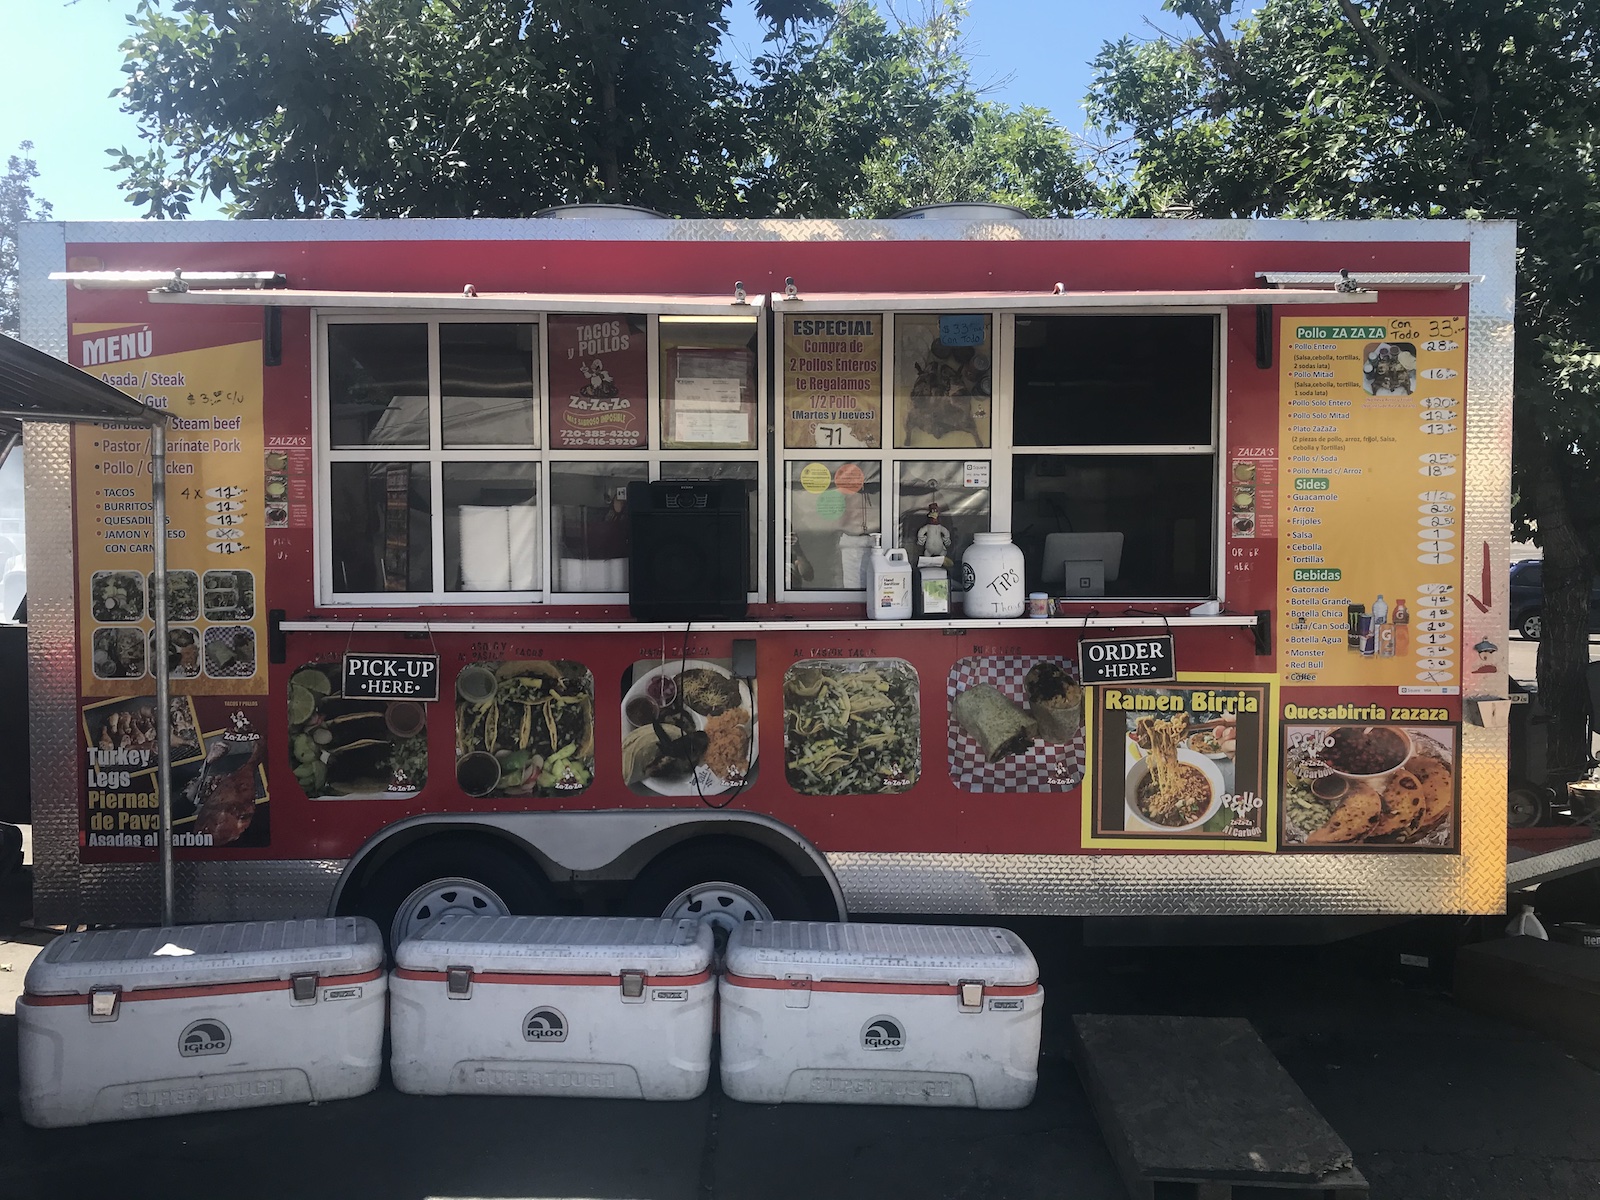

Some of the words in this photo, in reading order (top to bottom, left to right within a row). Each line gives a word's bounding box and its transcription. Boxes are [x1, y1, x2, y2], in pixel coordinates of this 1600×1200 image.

[577, 321, 621, 342] TACOS
[793, 320, 874, 336] ESPECIAL
[1297, 327, 1327, 338] Pollo
[1332, 328, 1348, 338] ZA
[1350, 328, 1366, 338] ZA
[1368, 328, 1384, 338] ZA
[83, 326, 153, 366] MENÚ
[578, 335, 630, 357] POLLOS
[804, 339, 848, 354] Compra
[850, 339, 863, 353] de
[790, 359, 797, 372] 2
[799, 358, 833, 372] Pollos
[836, 358, 877, 372] Enteros
[101, 373, 138, 386] Asada
[151, 372, 185, 386] Steak
[796, 378, 807, 390] te
[809, 377, 871, 391] Regalamos
[145, 396, 168, 408] Gut
[569, 395, 631, 411] Za-Za-Za
[809, 395, 826, 409] 1/2
[829, 395, 857, 409] Pollo
[792, 410, 829, 420] (Martes
[831, 412, 837, 421] y
[838, 410, 874, 420] Jueves)
[172, 417, 210, 430] Steam
[214, 416, 241, 430] beef
[560, 430, 640, 438] 720-385-4200
[103, 440, 141, 452] Pastor
[163, 439, 209, 452] arínate
[213, 440, 241, 452] Pork
[269, 437, 307, 446] ZALZA'S
[562, 438, 638, 446] 720-416-3920
[1238, 448, 1275, 456] ZALZA'S
[103, 461, 133, 474] Pollo
[147, 461, 193, 474] Ccken
[1296, 479, 1327, 489] Sides
[104, 488, 135, 497] TACOS
[181, 487, 189, 499] 4
[1293, 493, 1338, 501] Guacamole
[104, 502, 153, 511] BURRITOS
[104, 516, 170, 525] QUESADILS
[1292, 517, 1321, 526] Frijoles
[105, 530, 141, 538] JAMON
[144, 530, 149, 538] Y
[1292, 531, 1313, 539] Salsa
[105, 544, 127, 552] CON
[129, 544, 155, 552] CARN
[1292, 543, 1322, 551] Cebolla
[1293, 555, 1324, 563] Tortillas
[1295, 570, 1341, 581] Bebidas
[1291, 585, 1329, 593] Gatorade
[1291, 610, 1319, 618] Botella
[1321, 610, 1343, 618] Chica
[1330, 622, 1350, 630] Soda
[1321, 636, 1342, 645] Agua
[1088, 642, 1164, 662] ORDER
[1291, 649, 1325, 657] Monster
[348, 659, 435, 678] PICK-UP
[1105, 663, 1151, 677] HERE
[1291, 661, 1306, 669] Red
[1308, 661, 1323, 669] Bull
[368, 680, 414, 694] HERE
[1105, 690, 1184, 711] Ramen
[1191, 690, 1257, 712] Birria
[1284, 703, 1385, 721] Quesabirria
[1391, 707, 1448, 720] zazaza
[87, 747, 150, 767] Turkey
[88, 769, 130, 789] Legs
[89, 791, 159, 809] Piernas
[91, 812, 114, 830] de
[118, 812, 160, 830] Pavo
[89, 833, 141, 847] Asadas
[144, 832, 158, 846] al
[168, 831, 213, 846] arbón
[527, 1029, 564, 1039] IGLOO
[184, 1042, 226, 1053] IGLOO
[865, 1038, 901, 1047] IGLOO
